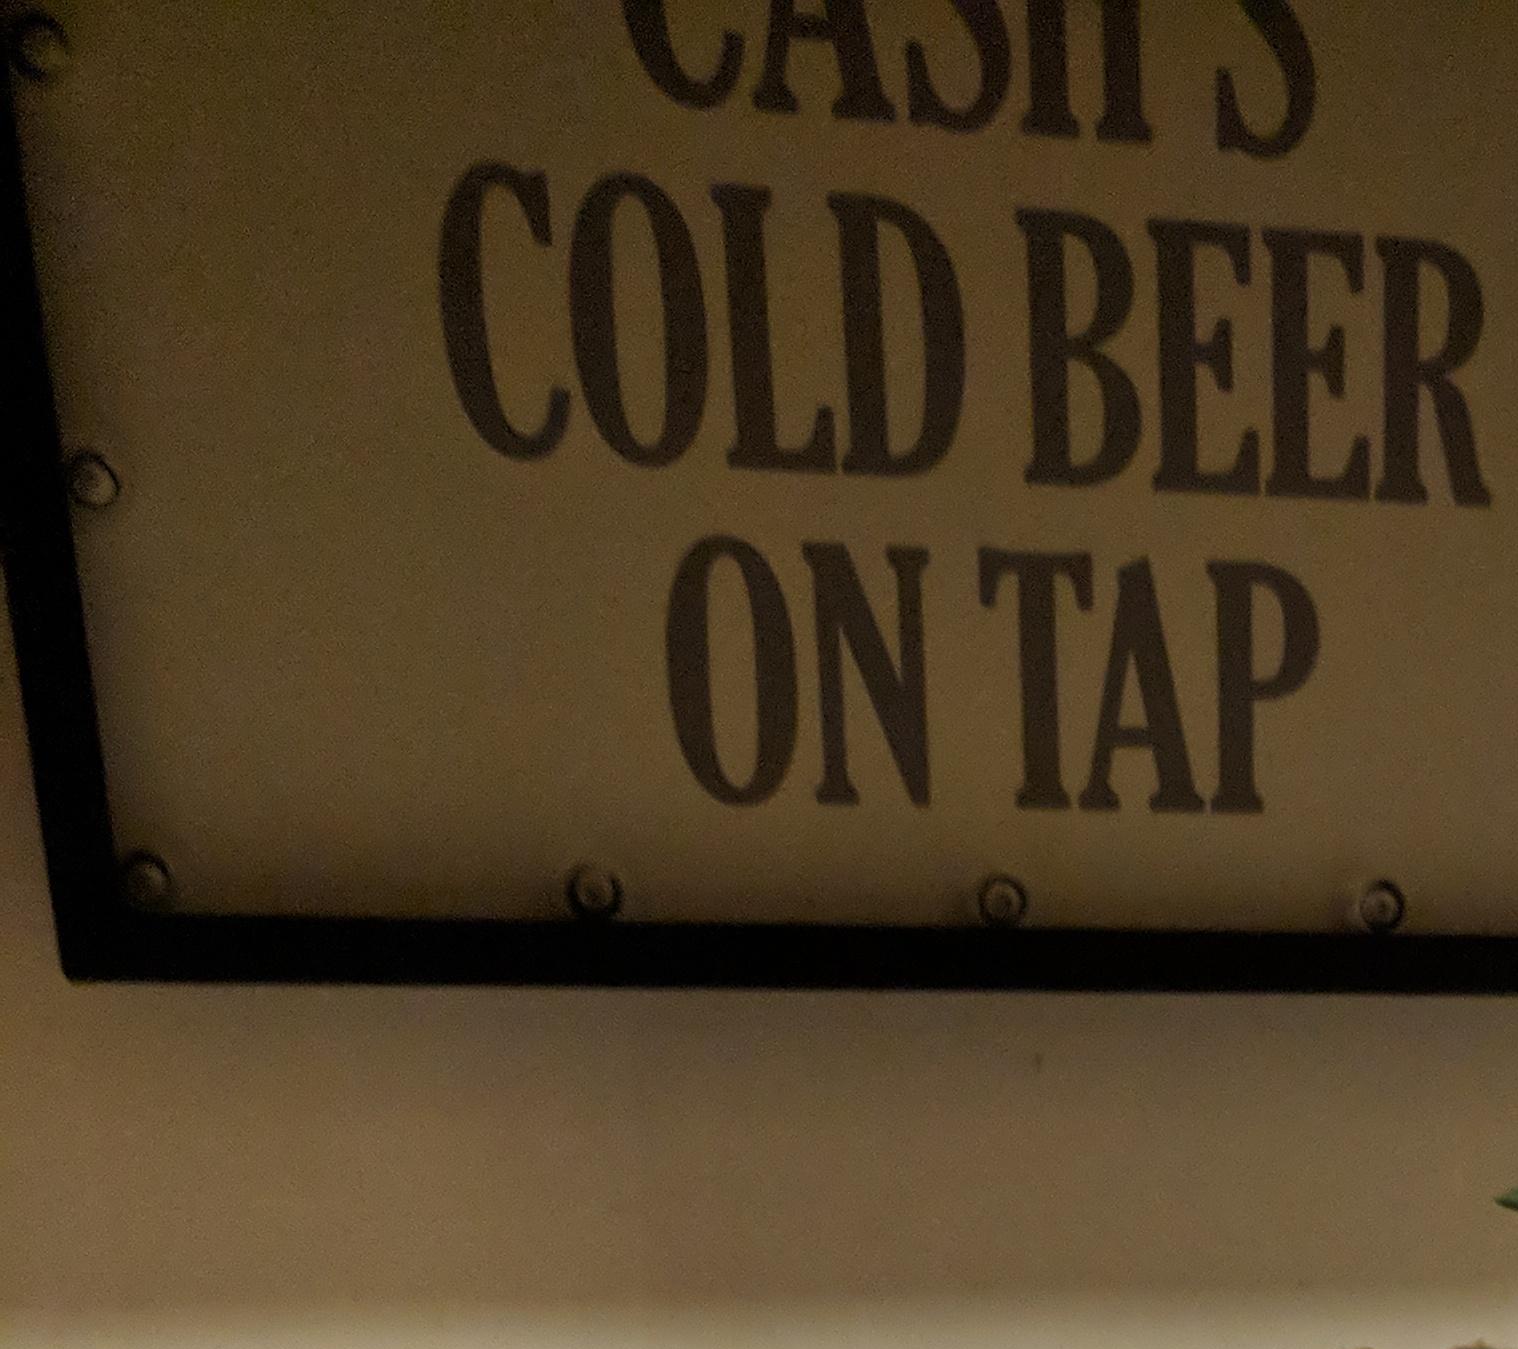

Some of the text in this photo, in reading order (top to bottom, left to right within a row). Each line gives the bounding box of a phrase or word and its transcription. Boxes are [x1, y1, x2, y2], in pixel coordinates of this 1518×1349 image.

[437, 160, 1494, 509] COLD BEER
[664, 534, 1322, 815] ON TAP
